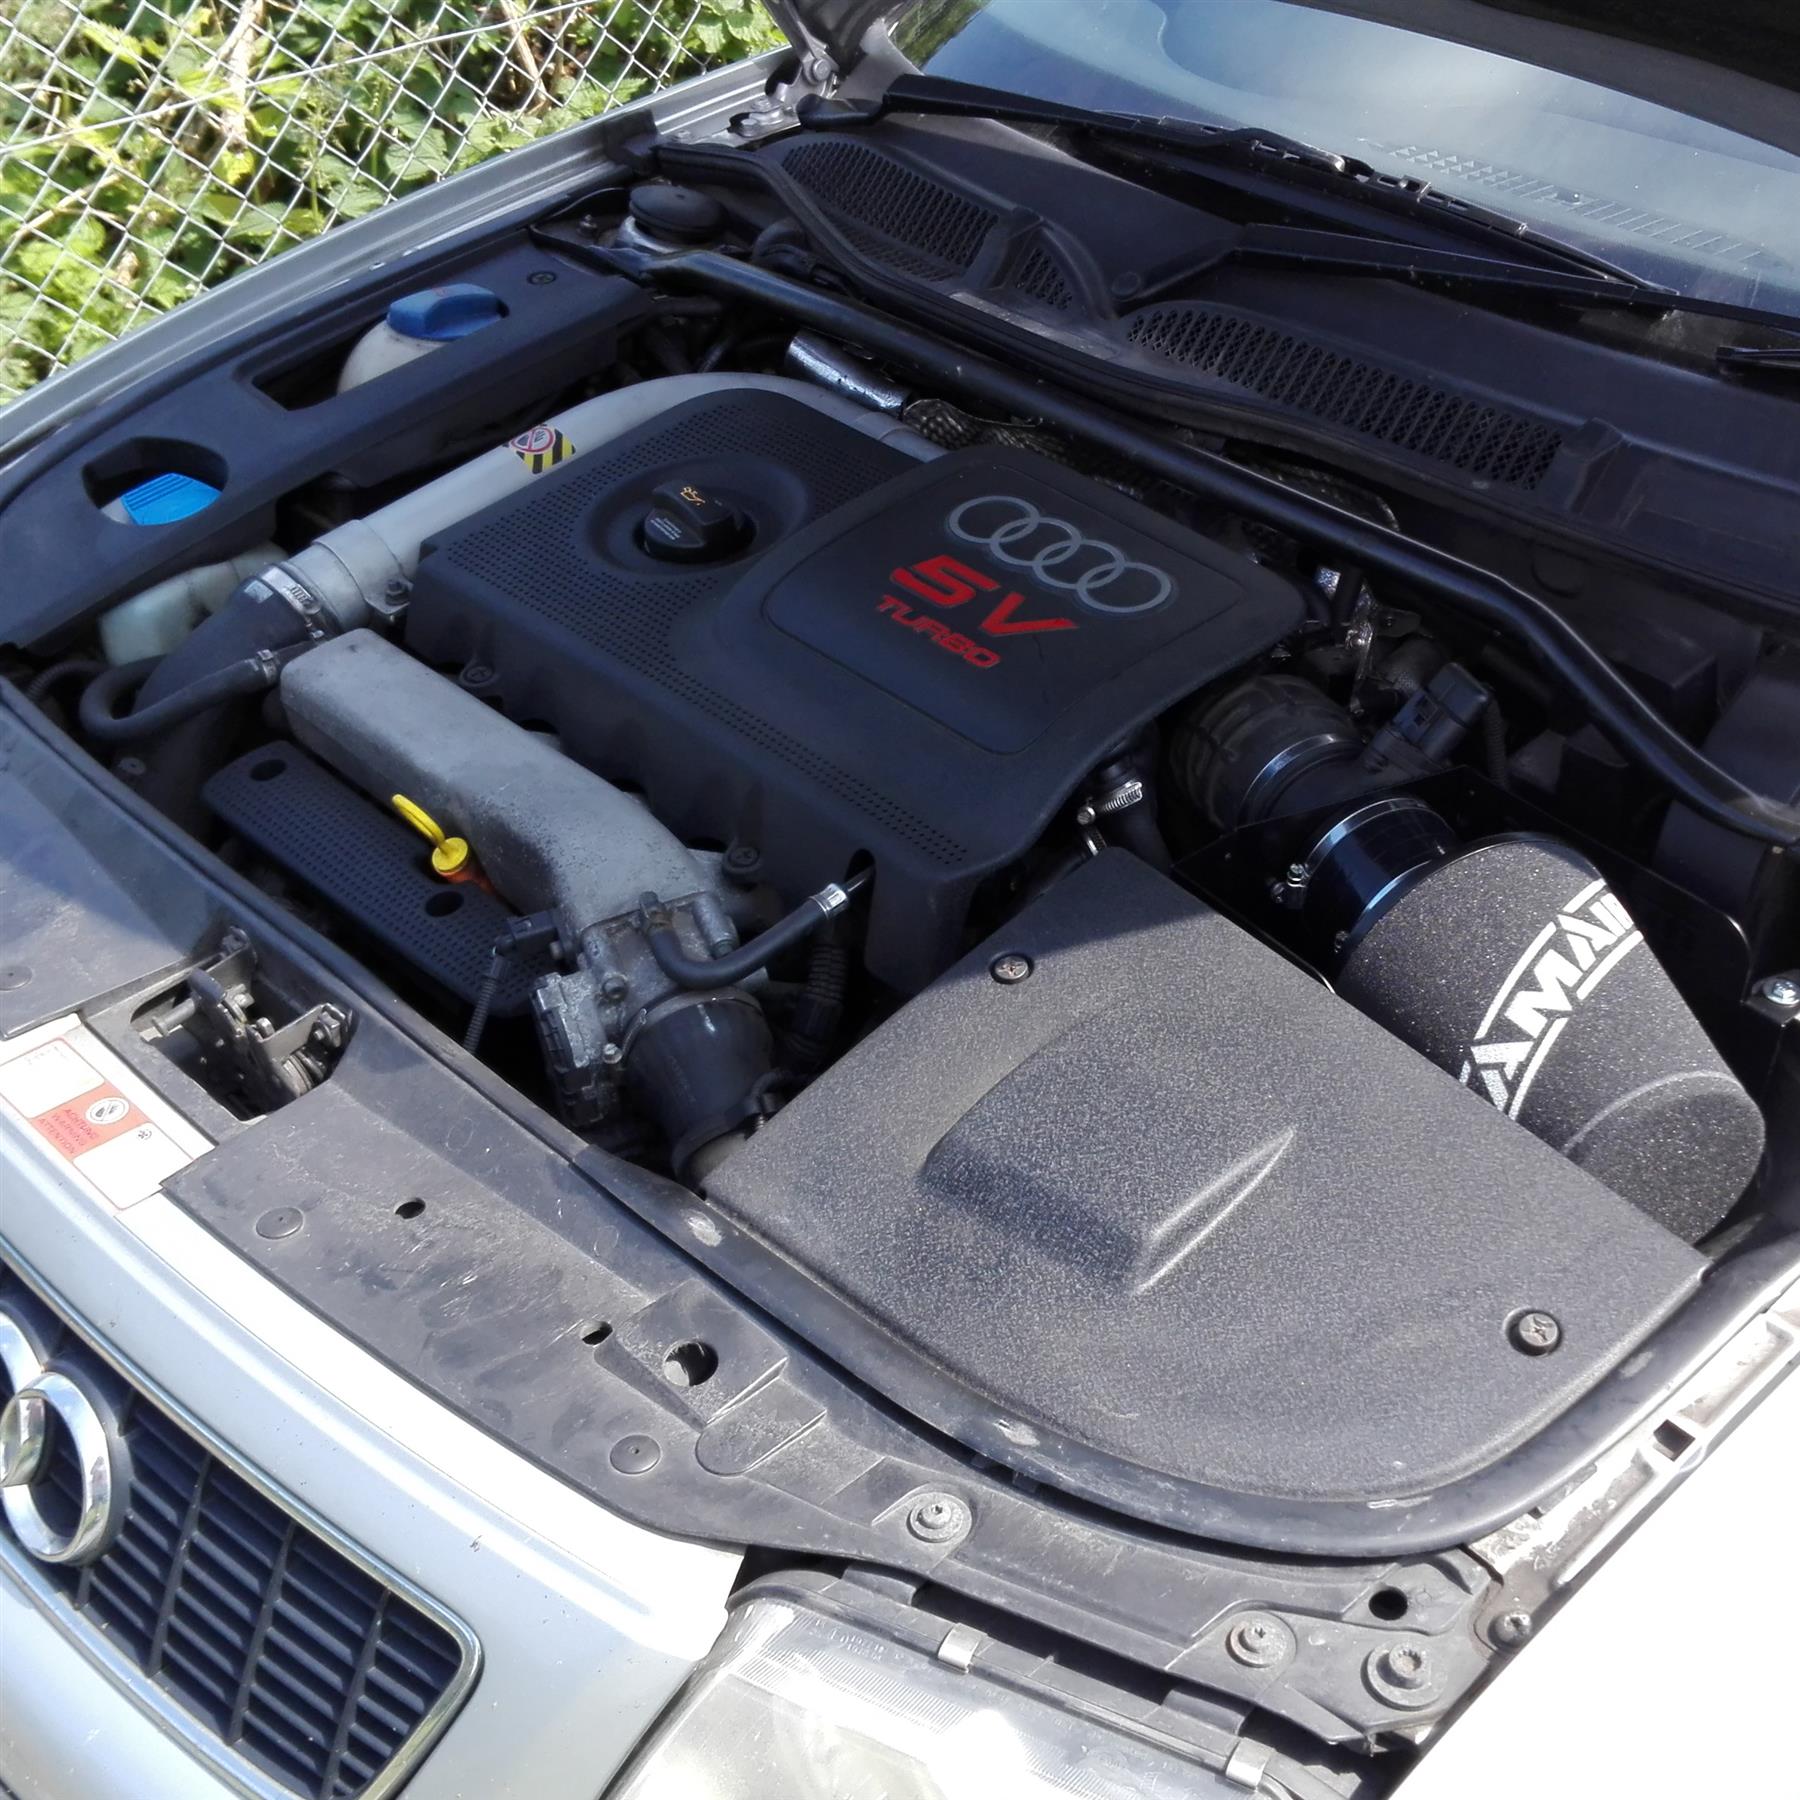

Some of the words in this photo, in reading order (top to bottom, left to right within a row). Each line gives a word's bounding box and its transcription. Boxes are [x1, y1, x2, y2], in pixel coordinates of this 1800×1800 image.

[890, 554, 1078, 635] 5V
[876, 595, 1000, 668] TURBO
[1459, 893, 1634, 1111] AMAI
[38, 1118, 76, 1154] ATTENTION
[64, 1109, 98, 1140] ACHTUNG
